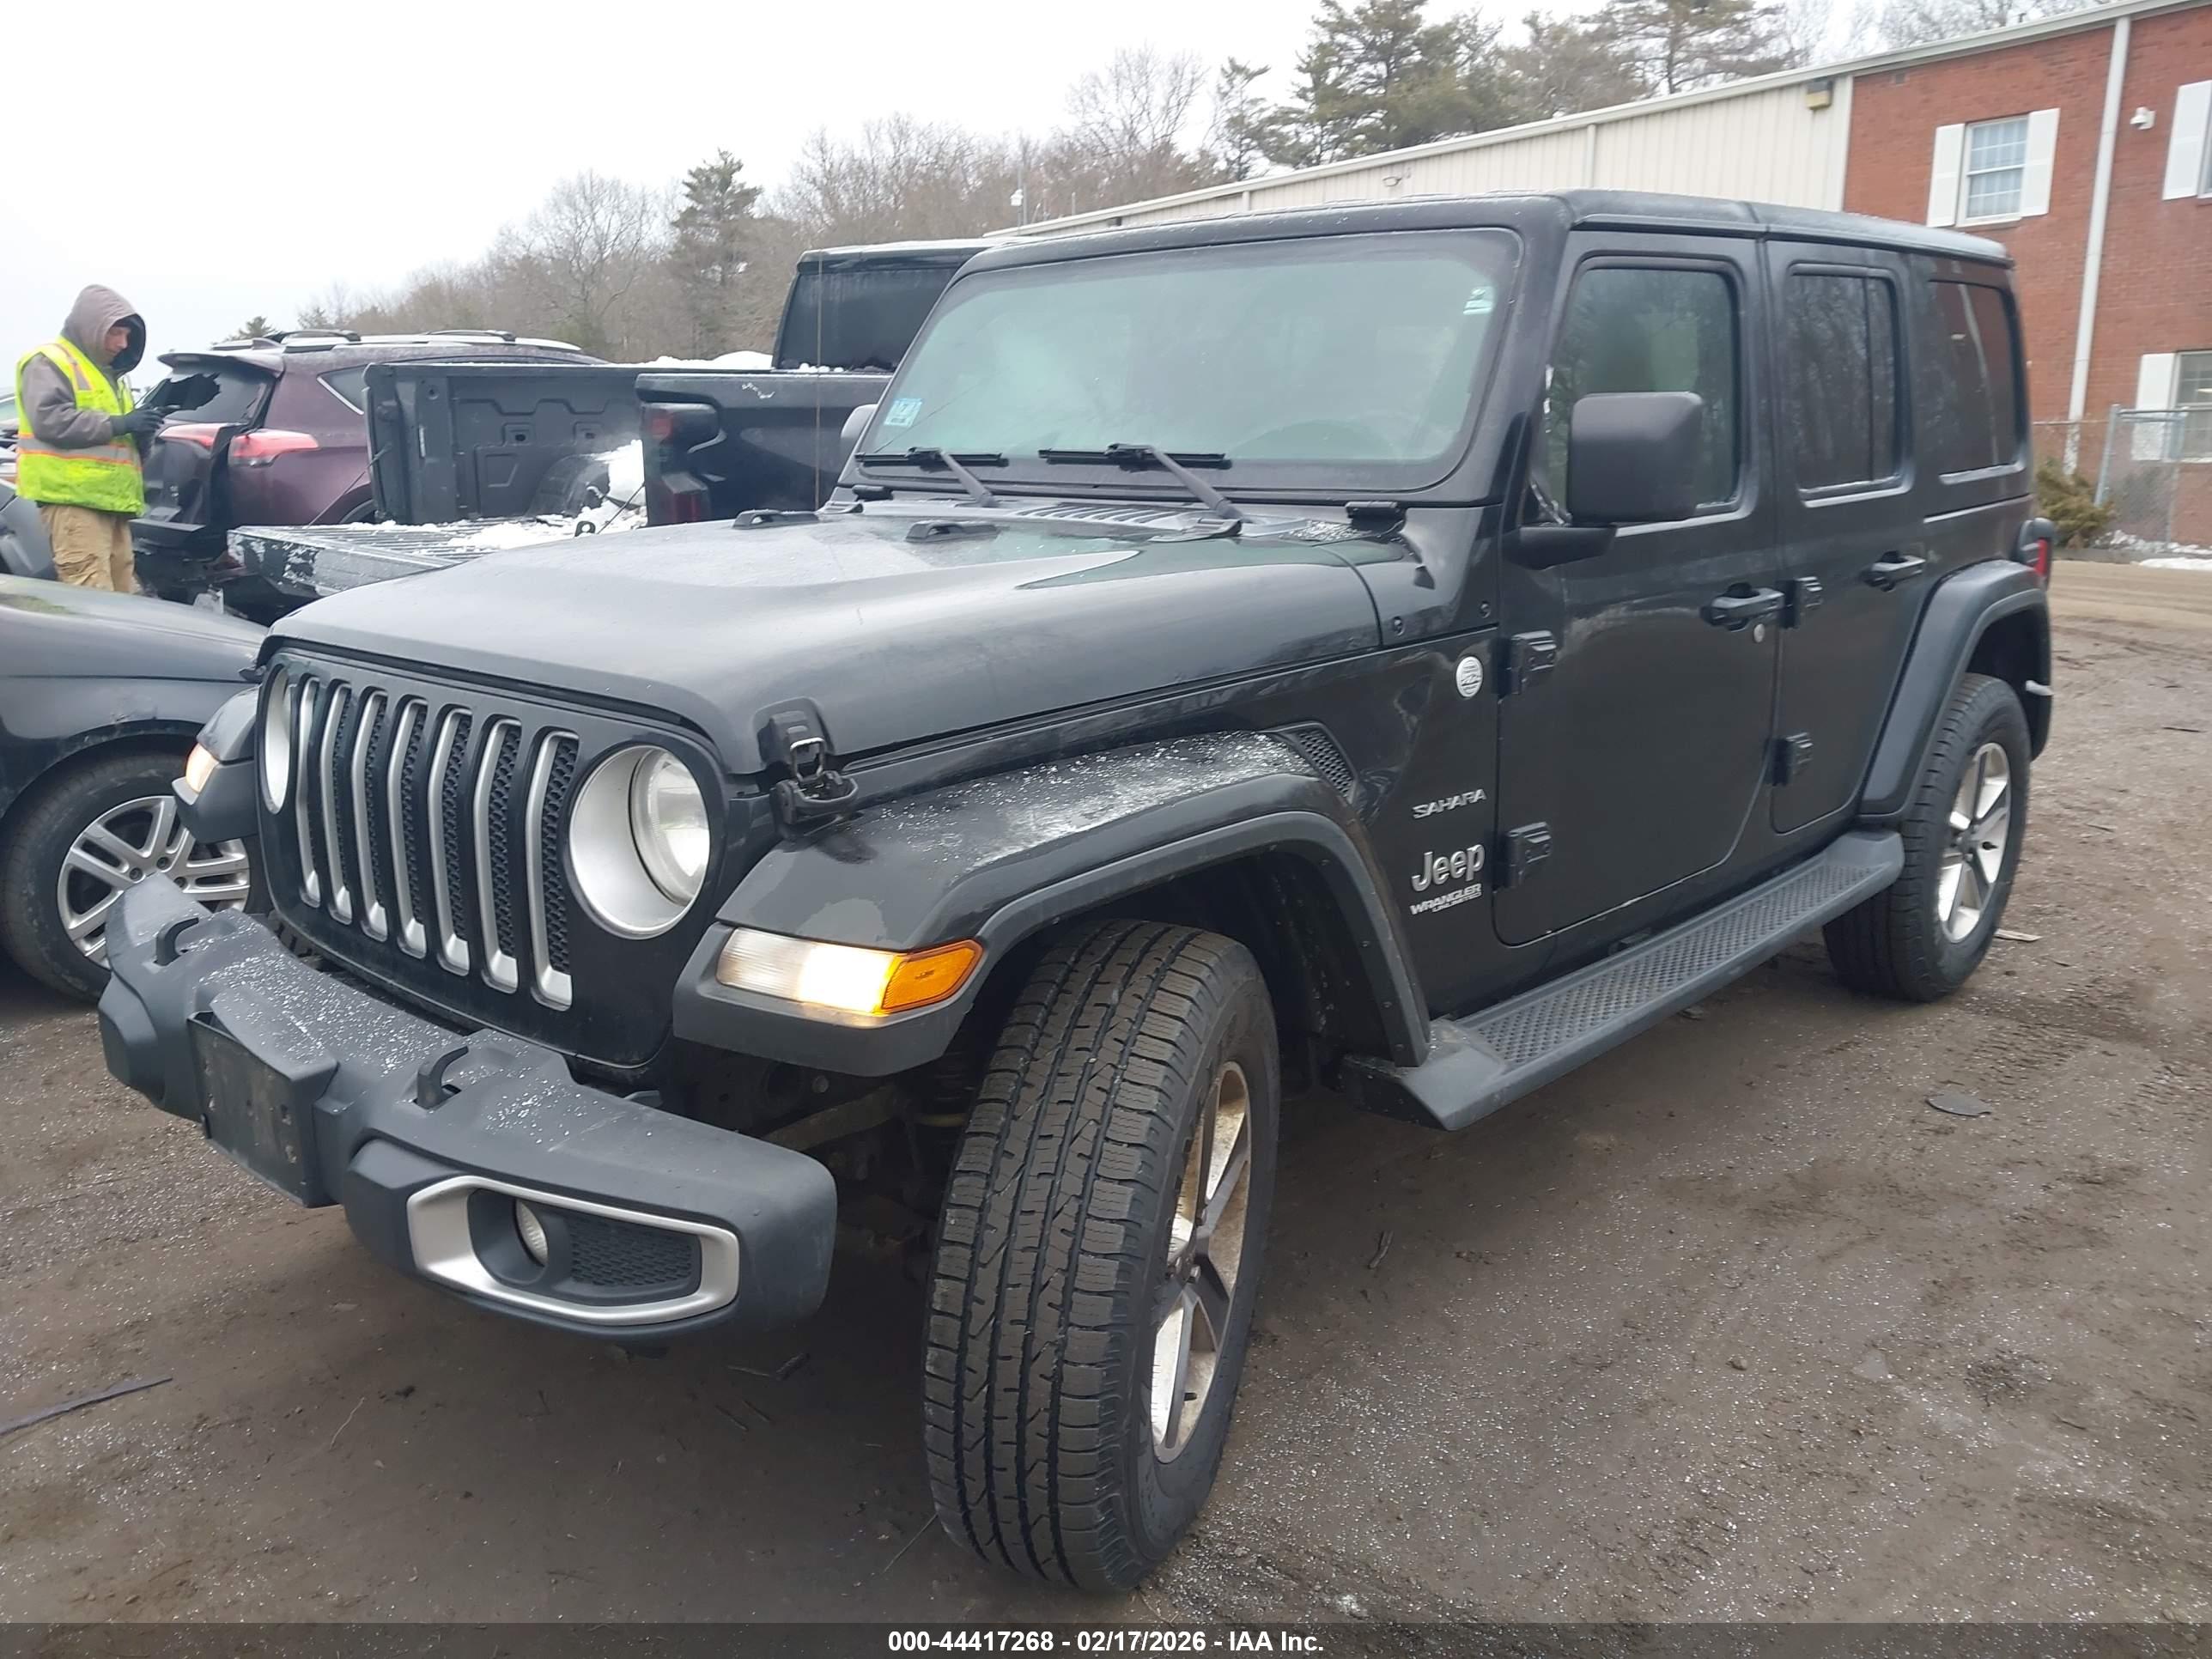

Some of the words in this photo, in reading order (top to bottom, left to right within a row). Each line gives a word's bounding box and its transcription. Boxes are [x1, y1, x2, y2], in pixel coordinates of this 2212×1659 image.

[1413, 788, 1486, 818] SAHARA
[1411, 844, 1486, 891] Jeep
[1409, 883, 1482, 915] WRANGLER
